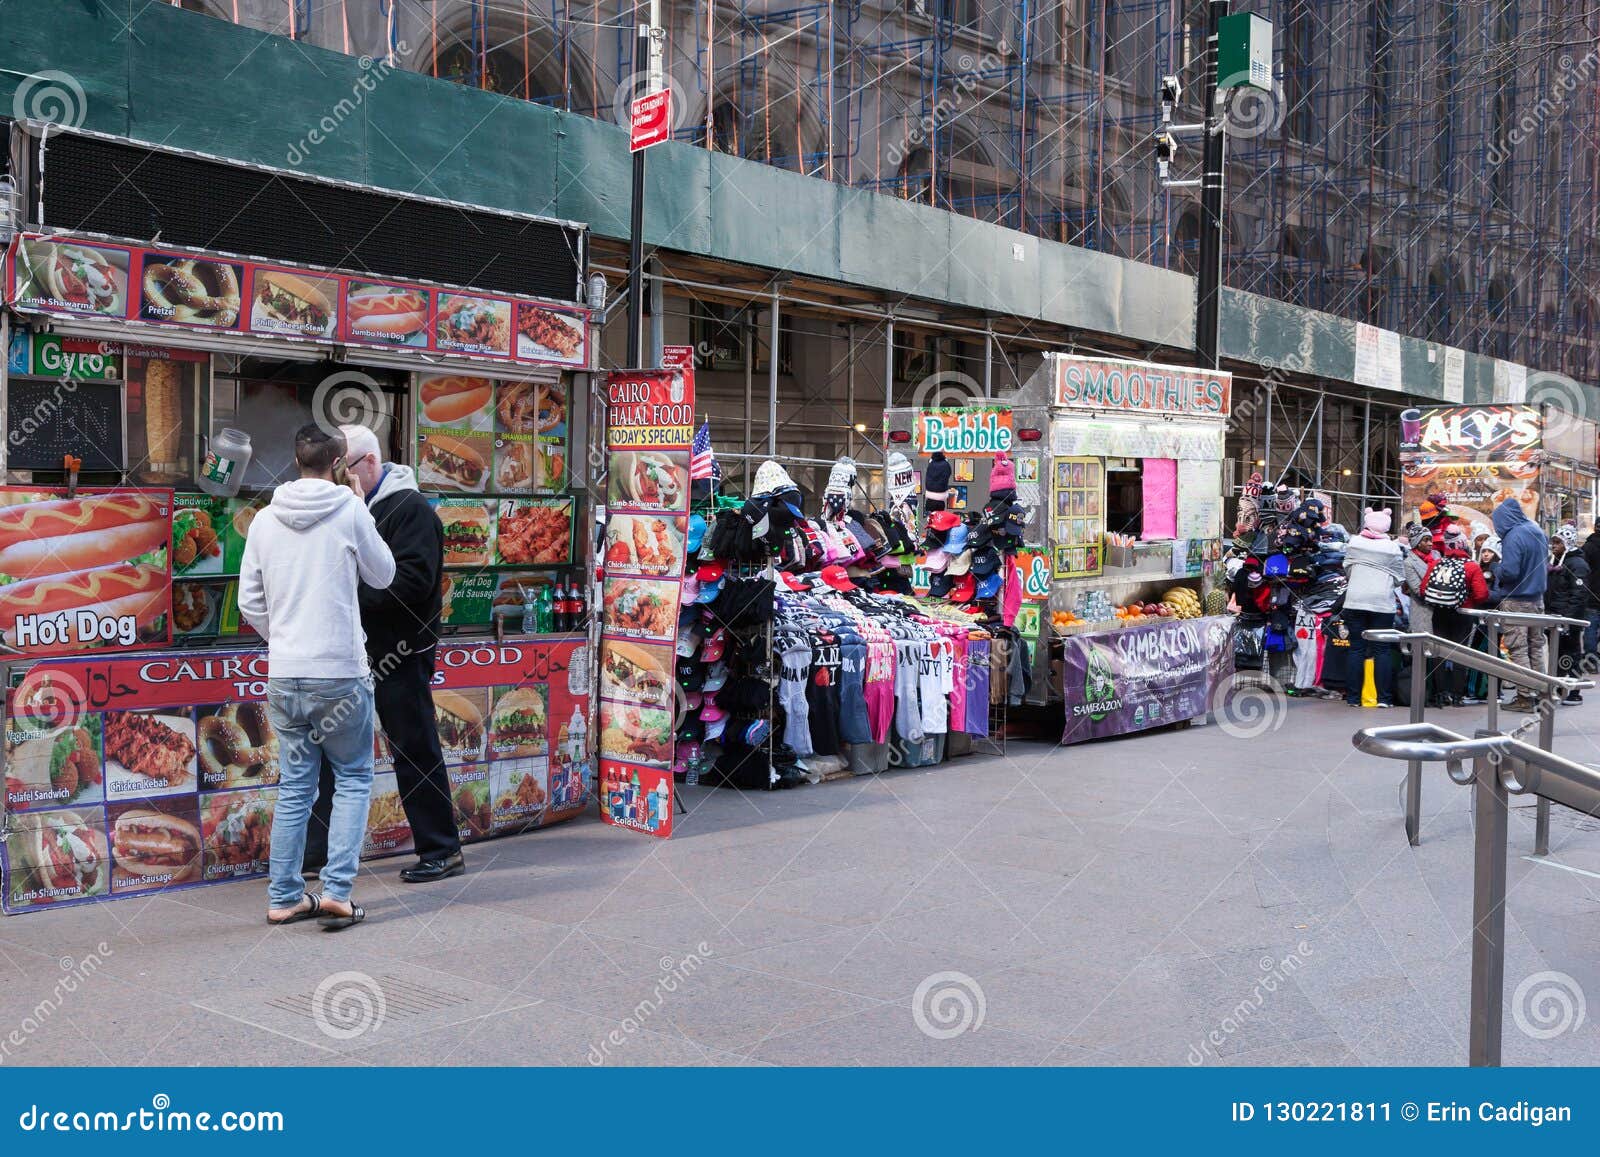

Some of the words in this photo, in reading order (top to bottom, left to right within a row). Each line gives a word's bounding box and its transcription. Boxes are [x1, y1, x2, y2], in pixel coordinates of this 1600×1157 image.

[47, 297, 94, 310] Shawarma
[148, 306, 176, 316] Pretzel
[351, 329, 376, 338] Jumbo
[376, 331, 389, 339] Hot
[390, 332, 405, 342] Dog
[42, 342, 104, 380] Gyro
[609, 382, 650, 403] CAIRO
[1064, 366, 1223, 412] SMOOTHIES
[609, 405, 650, 426] HALAL
[653, 405, 692, 425] FOOD
[609, 428, 646, 444] TODAY'S
[648, 428, 691, 444] SPECIALS
[924, 413, 1012, 453] Bubble
[1420, 411, 1538, 447] ALY'S
[894, 471, 913, 486] NEW
[173, 497, 213, 506] Sandwich
[463, 577, 476, 587] Hot
[477, 577, 492, 588] Dog
[452, 589, 466, 598] Hot
[467, 589, 497, 600] Sausage
[15, 610, 70, 647] Hot
[77, 610, 138, 646] Dog
[1117, 625, 1201, 664] SAMBAZON
[920, 659, 940, 677] NY
[1073, 699, 1123, 717] SAMBAZON
[110, 781, 142, 792] Chicken
[142, 778, 169, 788] Kebab
[203, 772, 228, 783] Pretzel
[451, 771, 486, 784] Vegetarian
[8, 792, 34, 804] Falafel
[34, 788, 70, 801] Sandwich
[614, 815, 631, 827] Cold
[207, 863, 234, 874] Chicken
[116, 877, 140, 888] Italian
[141, 873, 172, 885] Sausage
[13, 889, 37, 902] Lamb
[38, 885, 82, 898] Shawarma
